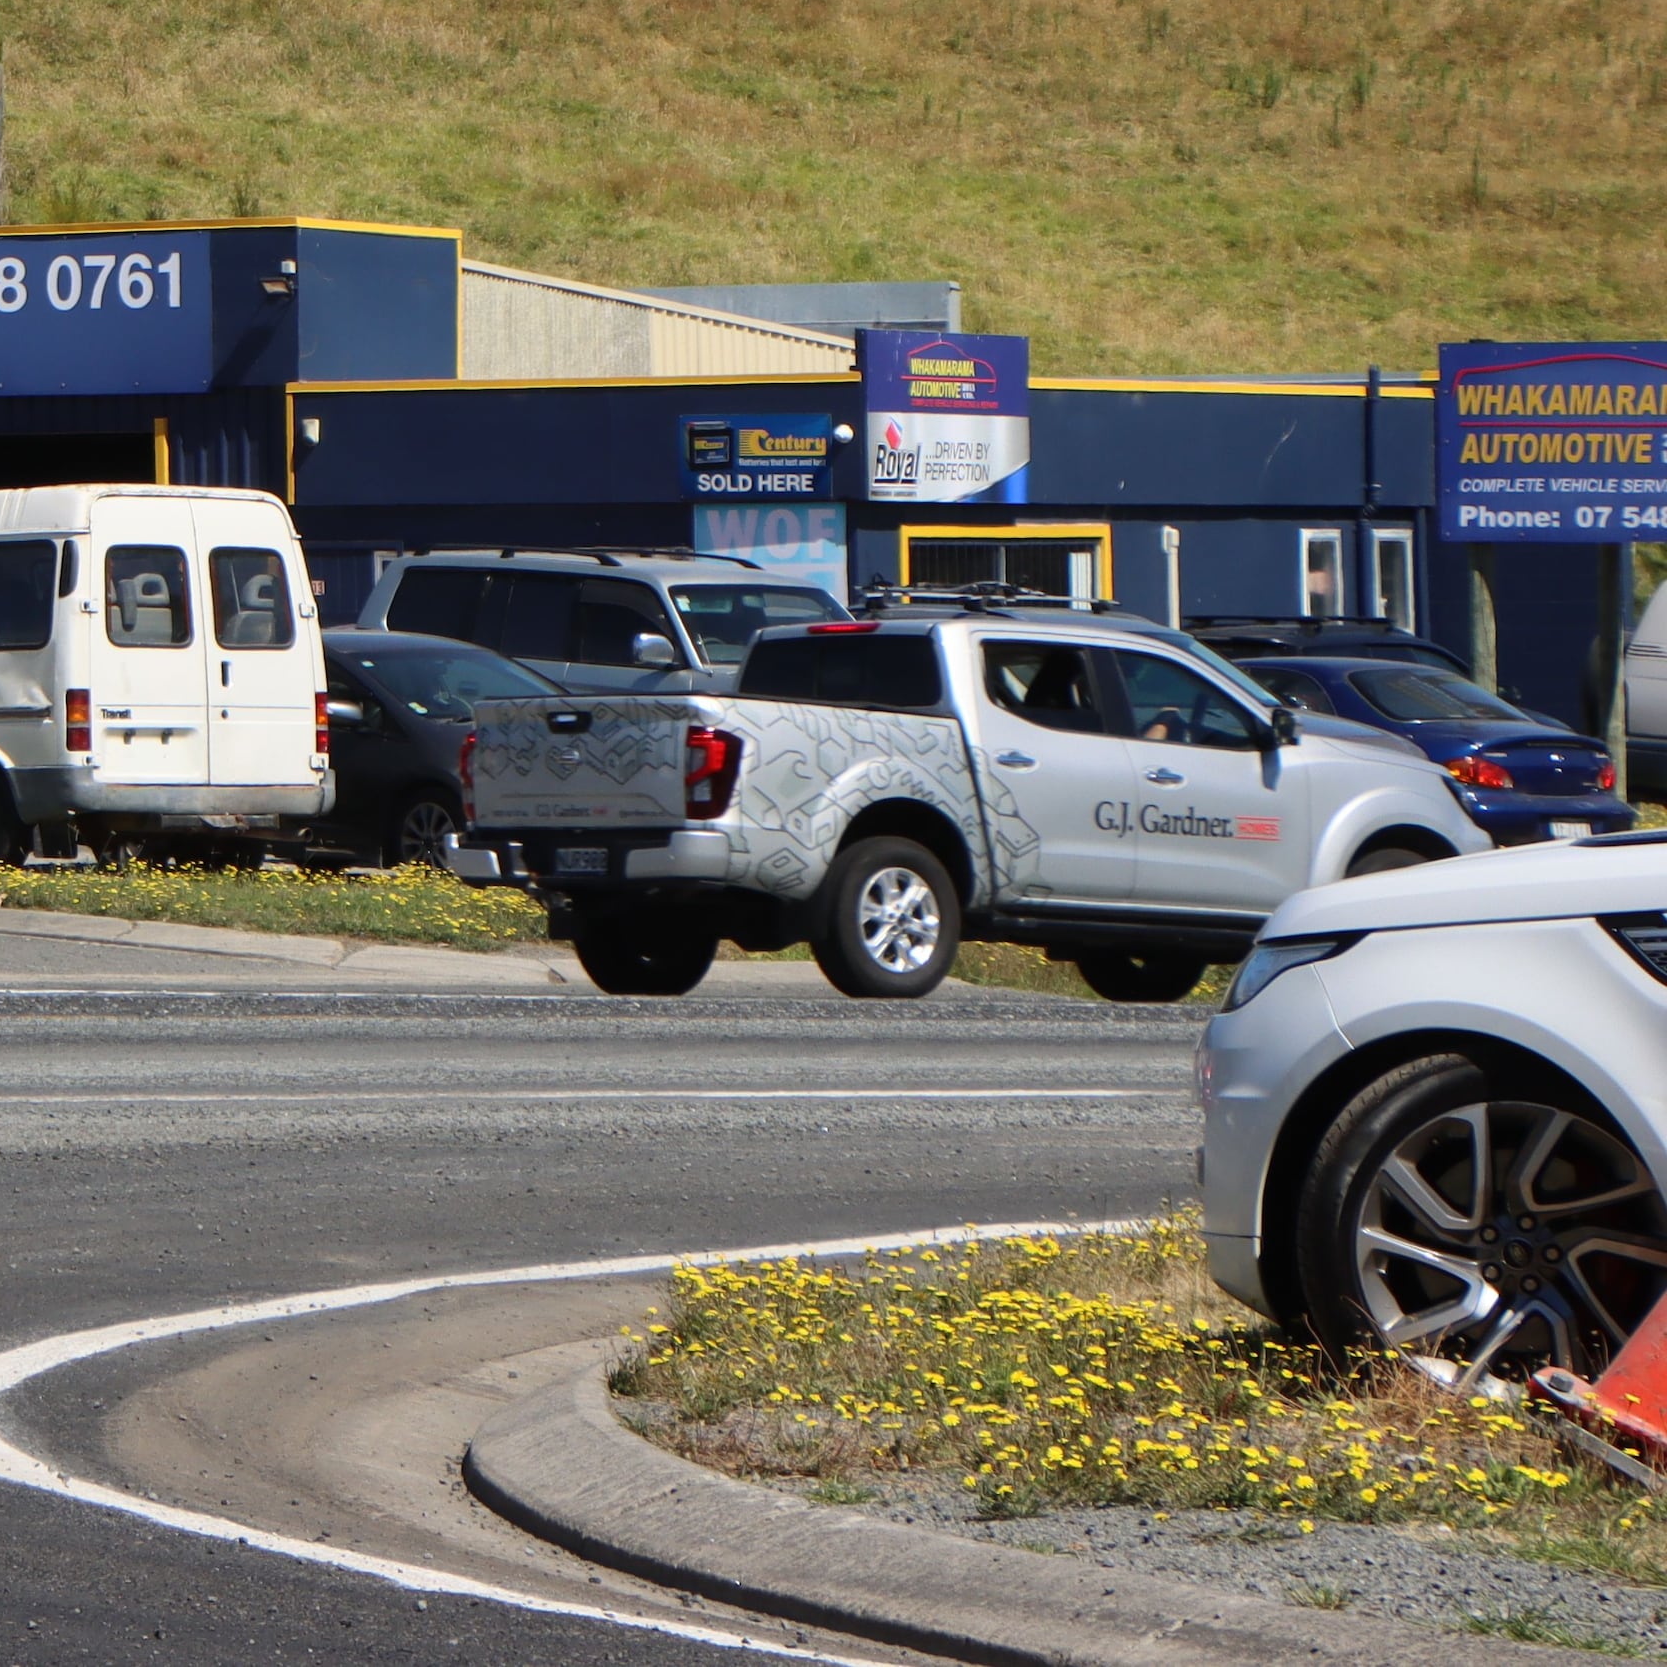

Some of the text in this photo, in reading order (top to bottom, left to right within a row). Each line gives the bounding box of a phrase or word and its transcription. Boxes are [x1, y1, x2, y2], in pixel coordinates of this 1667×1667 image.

[46, 252, 184, 311] 0761
[911, 358, 975, 377] WHAKAMARAMA
[910, 381, 961, 399] AUTOMOTIVE
[1457, 384, 1667, 416] WHAKAMARA
[739, 429, 827, 456] Century
[976, 443, 990, 460] BY
[1460, 433, 1653, 464] AUTOMOTIVE
[874, 443, 921, 484] Royal
[925, 463, 990, 482] PERFECTION
[698, 474, 814, 492] SOLD HERE
[1459, 478, 1546, 493] COMPLETE
[1551, 478, 1619, 493] VEHICLE
[1459, 505, 1561, 528] Phone:
[1575, 506, 1613, 528] 07
[706, 508, 837, 560] WOF
[1095, 801, 1134, 838] G.J.
[1139, 804, 1234, 838] Gardner.
